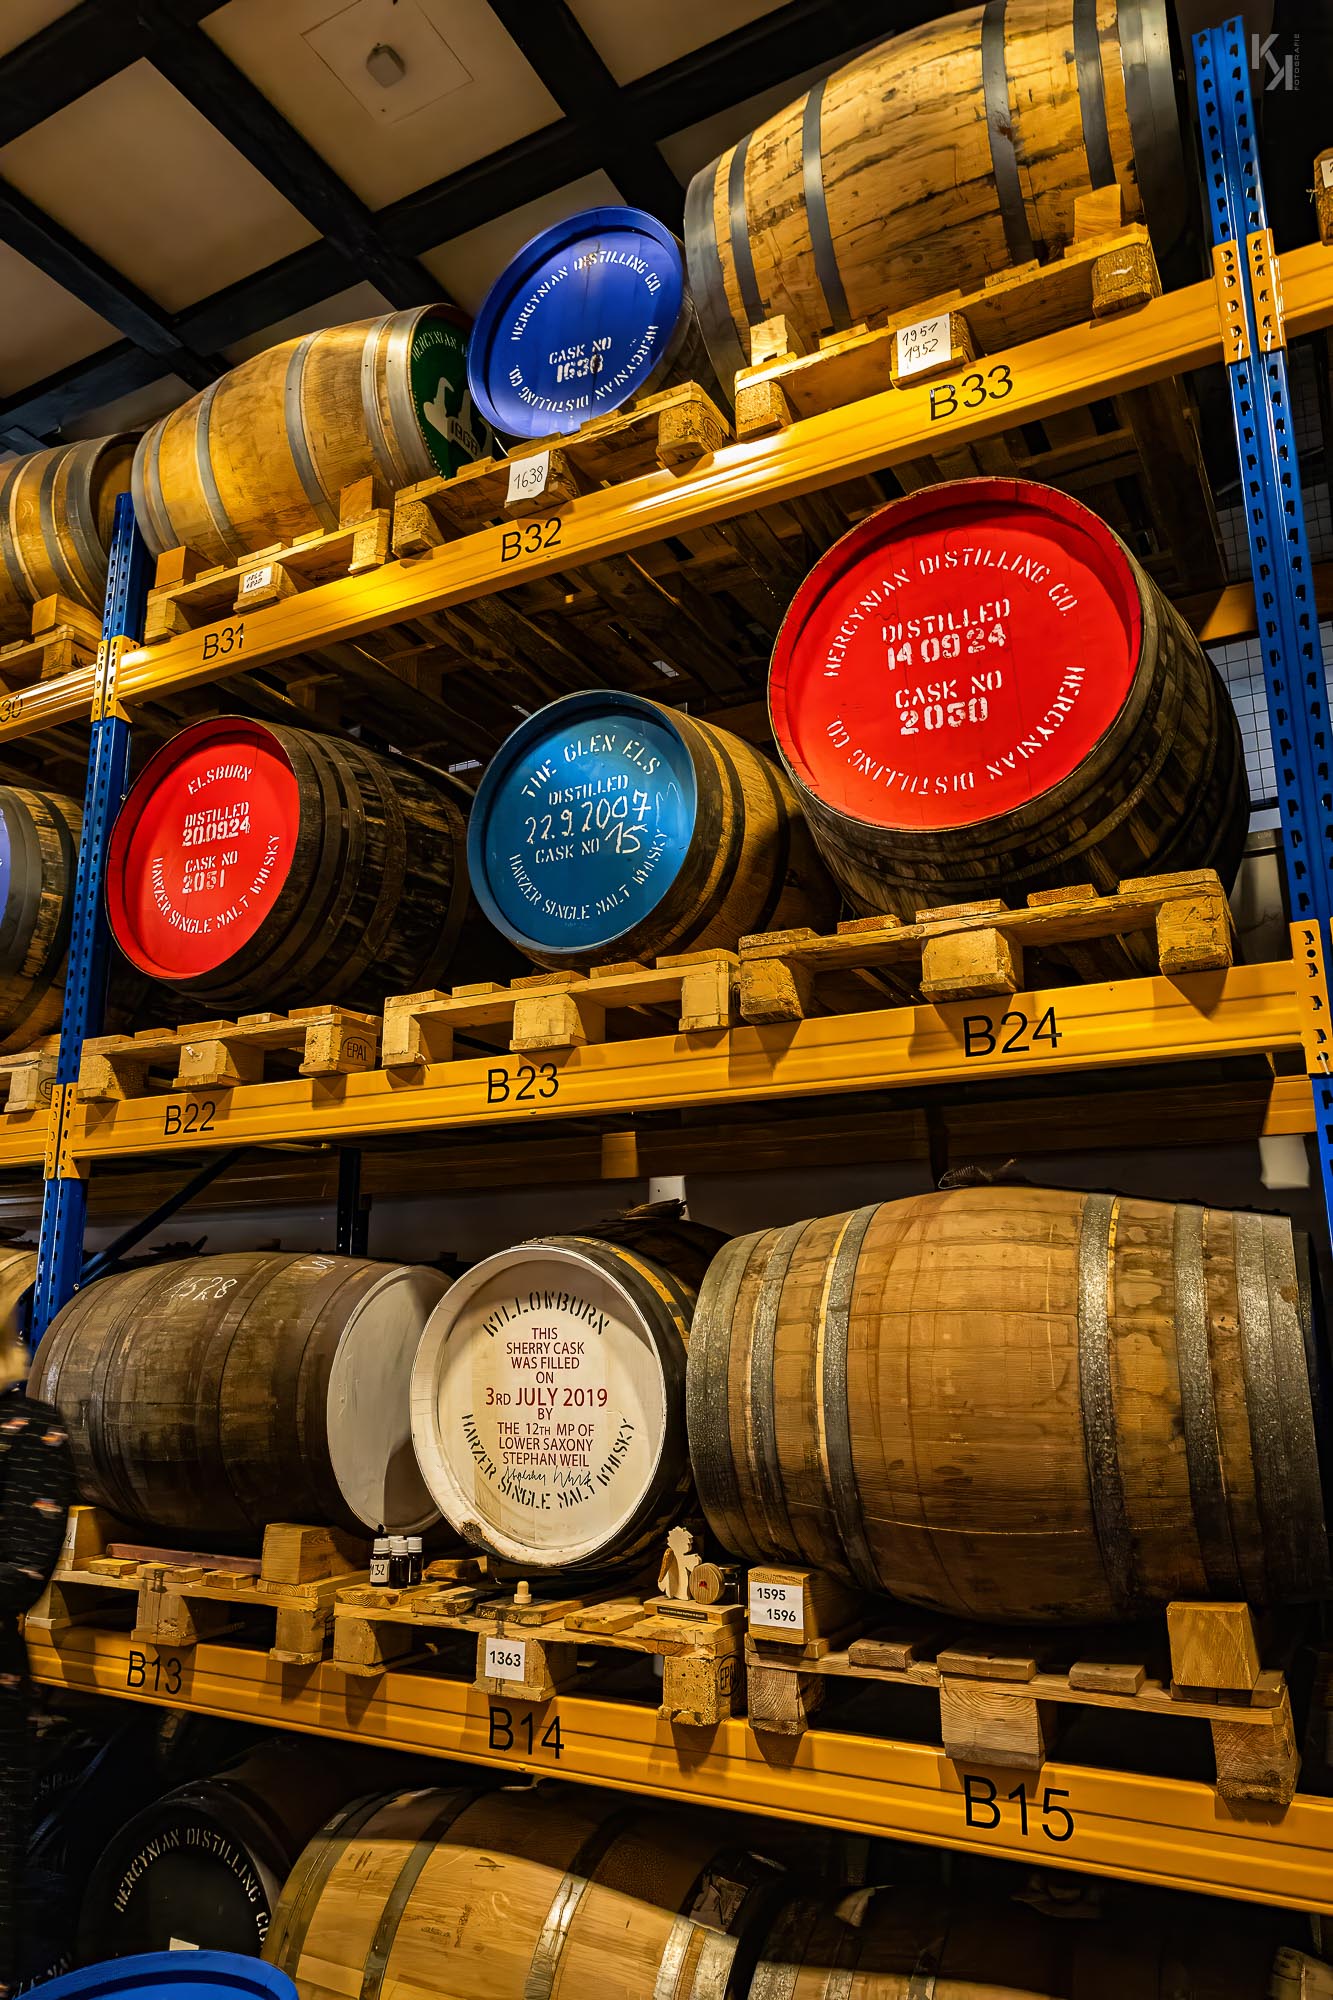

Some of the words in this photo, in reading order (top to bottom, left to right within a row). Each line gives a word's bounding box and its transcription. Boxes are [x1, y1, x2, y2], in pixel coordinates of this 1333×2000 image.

[511, 266, 569, 340] HERCYNIAN
[574, 250, 648, 274] DISTILLING
[549, 344, 585, 364] CASK
[592, 336, 611, 352] NO
[903, 322, 938, 345] 1951
[904, 339, 938, 362] 1952
[595, 325, 658, 400] HERCYNIAN
[518, 386, 589, 412] DISTILLING
[930, 365, 1013, 420] B33
[514, 465, 543, 489] 1638
[501, 517, 562, 562] B32
[824, 568, 910, 677] HERCYNIAN
[919, 548, 1050, 583] DISTILLING
[882, 599, 1010, 643] DISTILLED
[202, 623, 244, 660] B31
[896, 680, 957, 709] CASK
[971, 670, 1002, 694] NO
[986, 667, 1085, 780] HERCYNIAN
[187, 765, 252, 795] ELSBURN
[521, 759, 557, 798] THE
[564, 734, 616, 762] GLEN
[623, 739, 660, 775] ELS
[848, 749, 974, 795] DISTILLING
[549, 775, 628, 806] DISTILLED
[185, 802, 249, 828] DISTILLED
[536, 844, 574, 863] CASK
[582, 838, 600, 856] NO
[605, 821, 648, 854] 15
[185, 856, 216, 873] CASK
[222, 851, 238, 866] NO
[509, 854, 542, 906] HARZER
[542, 899, 590, 920] SINGLE
[596, 884, 631, 915] MALT
[632, 829, 668, 884] WHISKY
[152, 857, 171, 915] HARZER
[169, 910, 212, 933] SINGLE
[216, 895, 249, 929] MALT
[250, 835, 280, 894] WHISKY
[963, 1007, 1062, 1057] B24
[488, 1063, 559, 1103] B23
[164, 1101, 216, 1135] B22
[482, 1290, 609, 1337] WILLOWBURN
[506, 1342, 550, 1355] SHERRY
[553, 1342, 585, 1355] CASK
[531, 1328, 558, 1340] THIS
[511, 1357, 537, 1369] WAS
[541, 1357, 580, 1369] FILLED
[535, 1371, 554, 1384] ON
[485, 1387, 511, 1406] 3RD
[516, 1387, 559, 1407] JULY
[563, 1388, 608, 1407] 2019
[537, 1408, 553, 1420] BY
[497, 1422, 520, 1435] THE
[525, 1422, 551, 1435] 12TH
[556, 1423, 576, 1436] MP
[578, 1424, 595, 1437] OF
[499, 1437, 541, 1450] LOWER
[543, 1438, 593, 1452] SAXONY
[462, 1414, 497, 1480] HARZER
[498, 1476, 551, 1510] SINGLE
[557, 1479, 596, 1509] MALT
[596, 1418, 635, 1487] WHISKY
[502, 1452, 557, 1466] STEPHAN
[560, 1454, 590, 1467] WEIL
[757, 1587, 786, 1601] 1595
[766, 1608, 797, 1622] 1596
[127, 1650, 182, 1695] B13
[490, 1650, 521, 1667] 1363
[489, 1706, 564, 1759] B14
[964, 1774, 1074, 1842] B15
[114, 1828, 180, 1913] HERCYNIAN
[186, 1828, 261, 1903] DISTILLING
